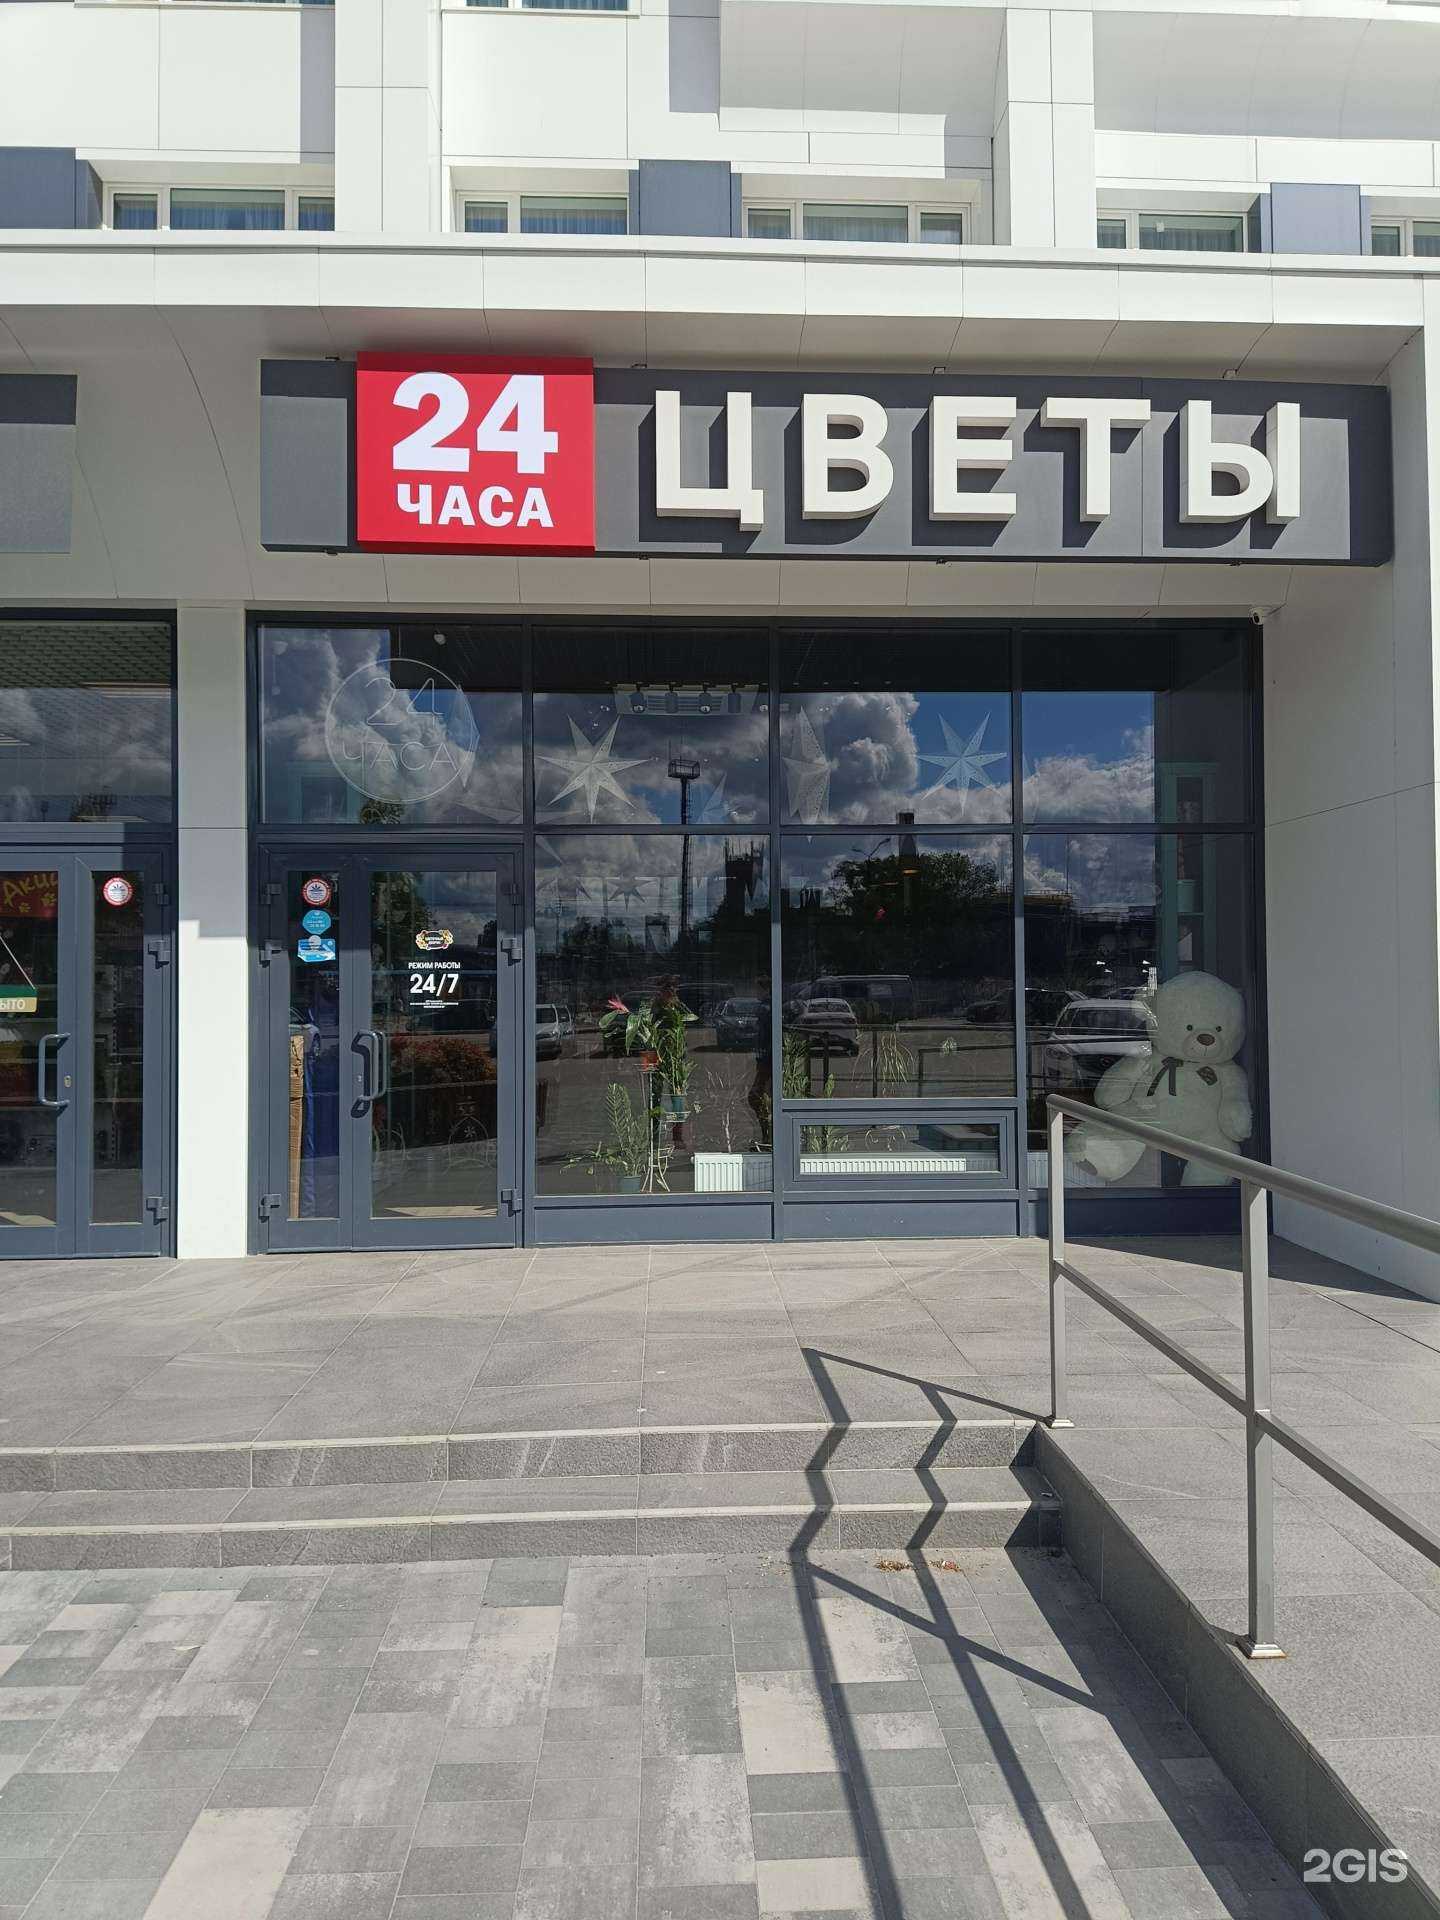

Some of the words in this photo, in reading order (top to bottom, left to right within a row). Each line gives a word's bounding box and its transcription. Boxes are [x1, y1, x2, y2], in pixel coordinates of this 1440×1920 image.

[393, 371, 559, 474] 24
[655, 390, 1300, 532] ЦВЕТЫ
[397, 483, 554, 528] ЧАСА
[366, 677, 444, 729] 24
[342, 741, 458, 771] ЧАСА
[408, 962, 433, 970] РЕЖИМ
[434, 961, 461, 969] РАБОТЫ
[410, 973, 459, 997] 24/7
